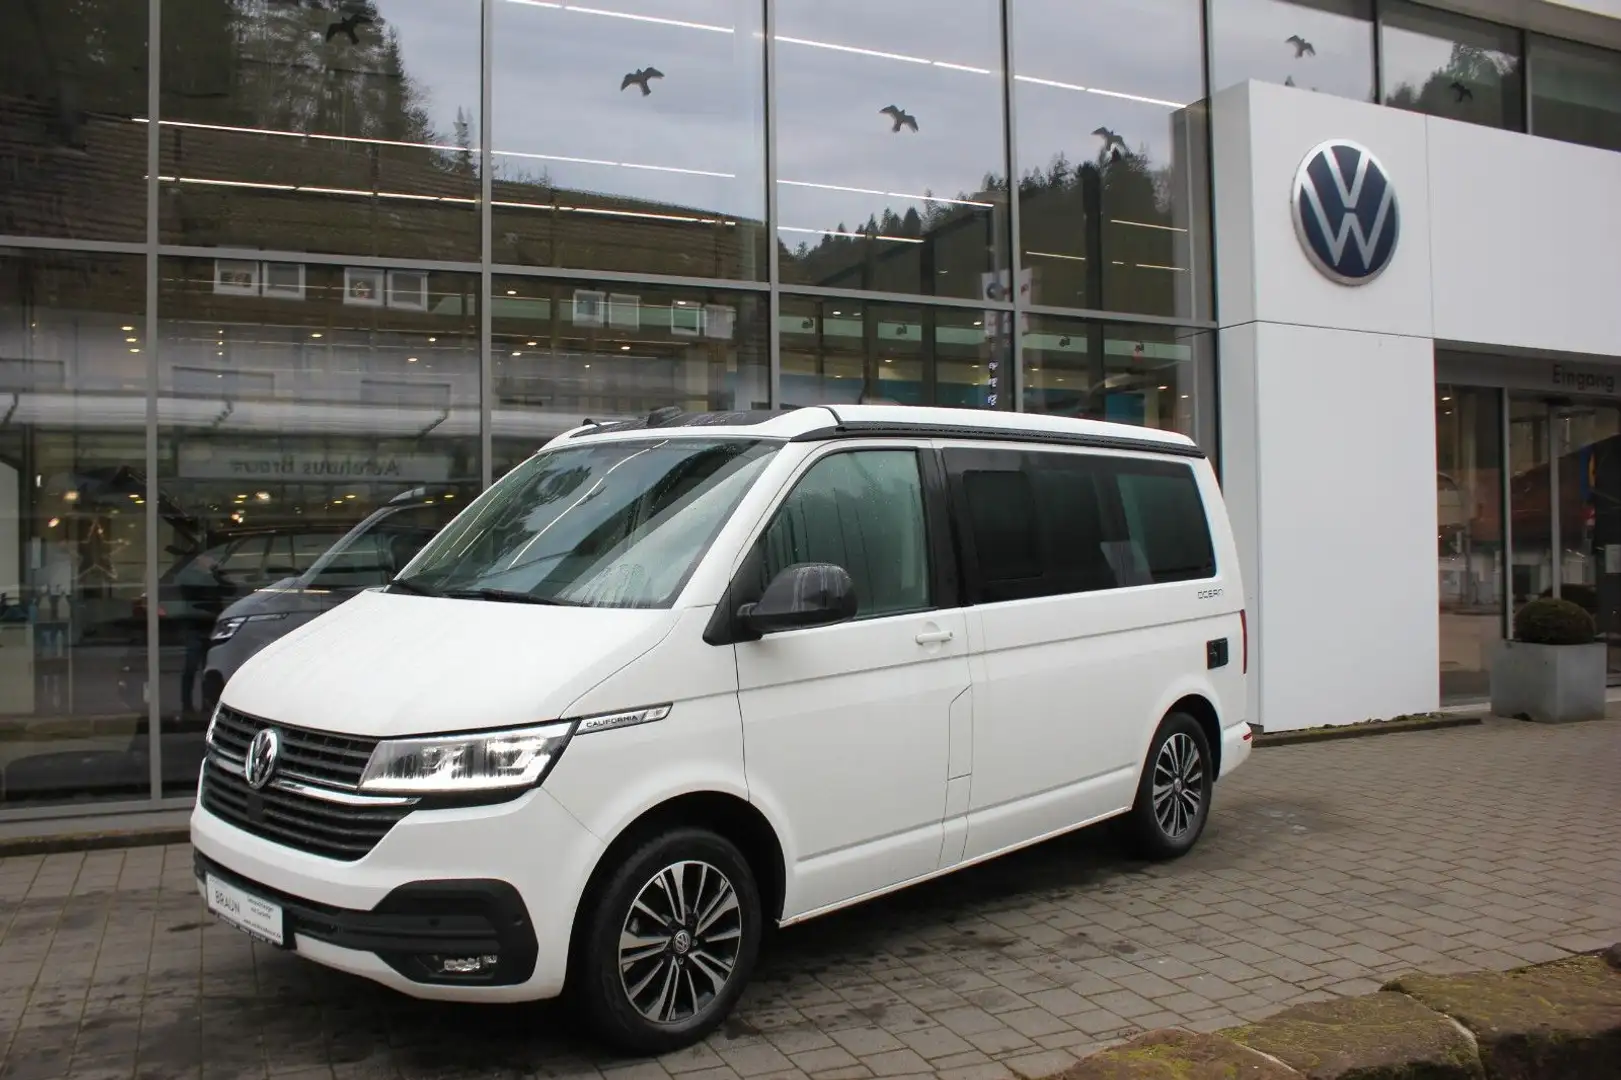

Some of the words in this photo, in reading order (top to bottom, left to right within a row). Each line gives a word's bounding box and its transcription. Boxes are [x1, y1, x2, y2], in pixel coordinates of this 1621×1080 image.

[1294, 140, 1400, 280] VW
[1552, 364, 1615, 392] Eingang
[586, 715, 639, 728] CALIFORNIA
[215, 889, 240, 914] BRAUN
